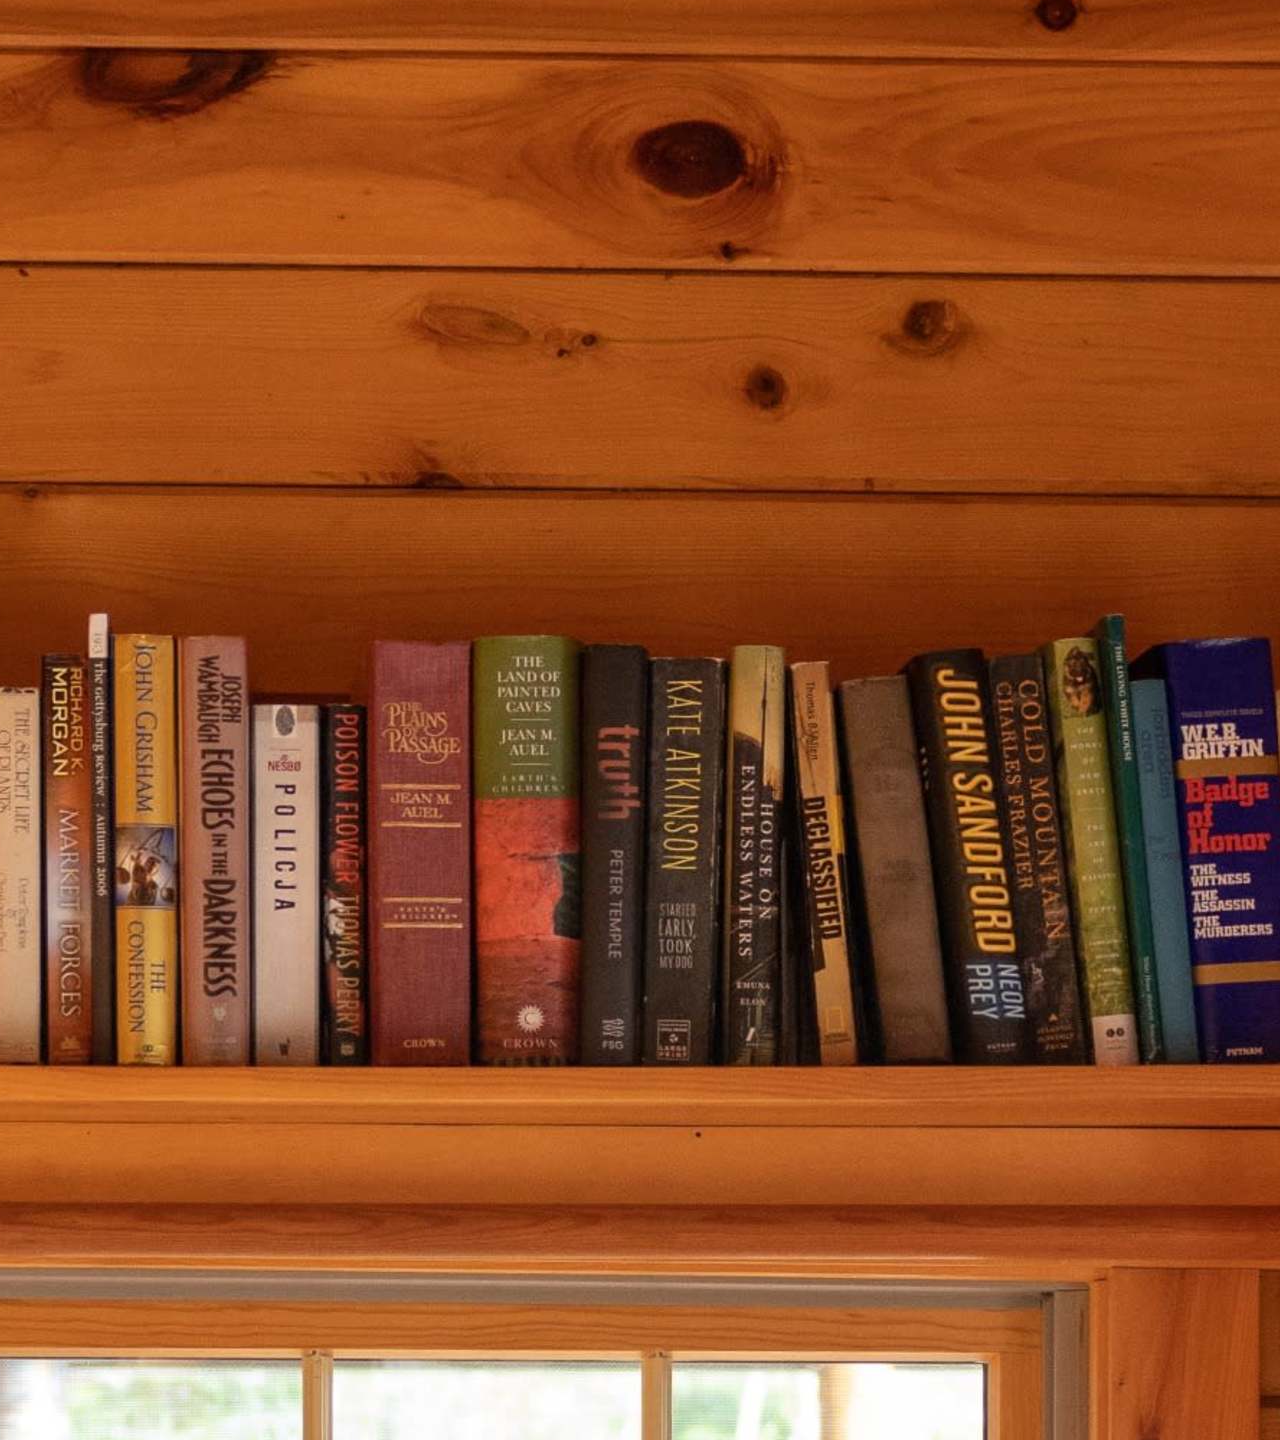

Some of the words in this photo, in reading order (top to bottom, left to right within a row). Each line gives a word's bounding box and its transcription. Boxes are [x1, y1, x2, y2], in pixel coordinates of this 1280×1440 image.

[134, 643, 156, 704] JOHN
[497, 686, 560, 699] PAINTED
[506, 700, 552, 713] CAVES
[667, 679, 703, 737] KATE
[52, 668, 68, 777] MORGAN
[334, 713, 358, 791] POISON
[937, 669, 984, 762] JOHN
[1181, 723, 1240, 742] W.E.B.
[1183, 739, 1264, 759] GRIFFIN
[135, 709, 158, 814] GRISHAM
[200, 749, 235, 830] ECHOES
[597, 723, 640, 820] truth
[1184, 777, 1269, 806] Badge
[273, 784, 298, 911] POLICJA
[334, 799, 359, 887] FLOWER
[661, 747, 701, 872] ATKINSON
[1188, 807, 1214, 830] of
[1188, 832, 1271, 854] Honor
[58, 810, 81, 910] MARKET
[953, 771, 1015, 954] SANDFORD
[59, 925, 81, 1017] FORCES
[204, 880, 238, 997] DARKNESS
[965, 964, 998, 1019] PREY
[997, 964, 1026, 1019] NEON
